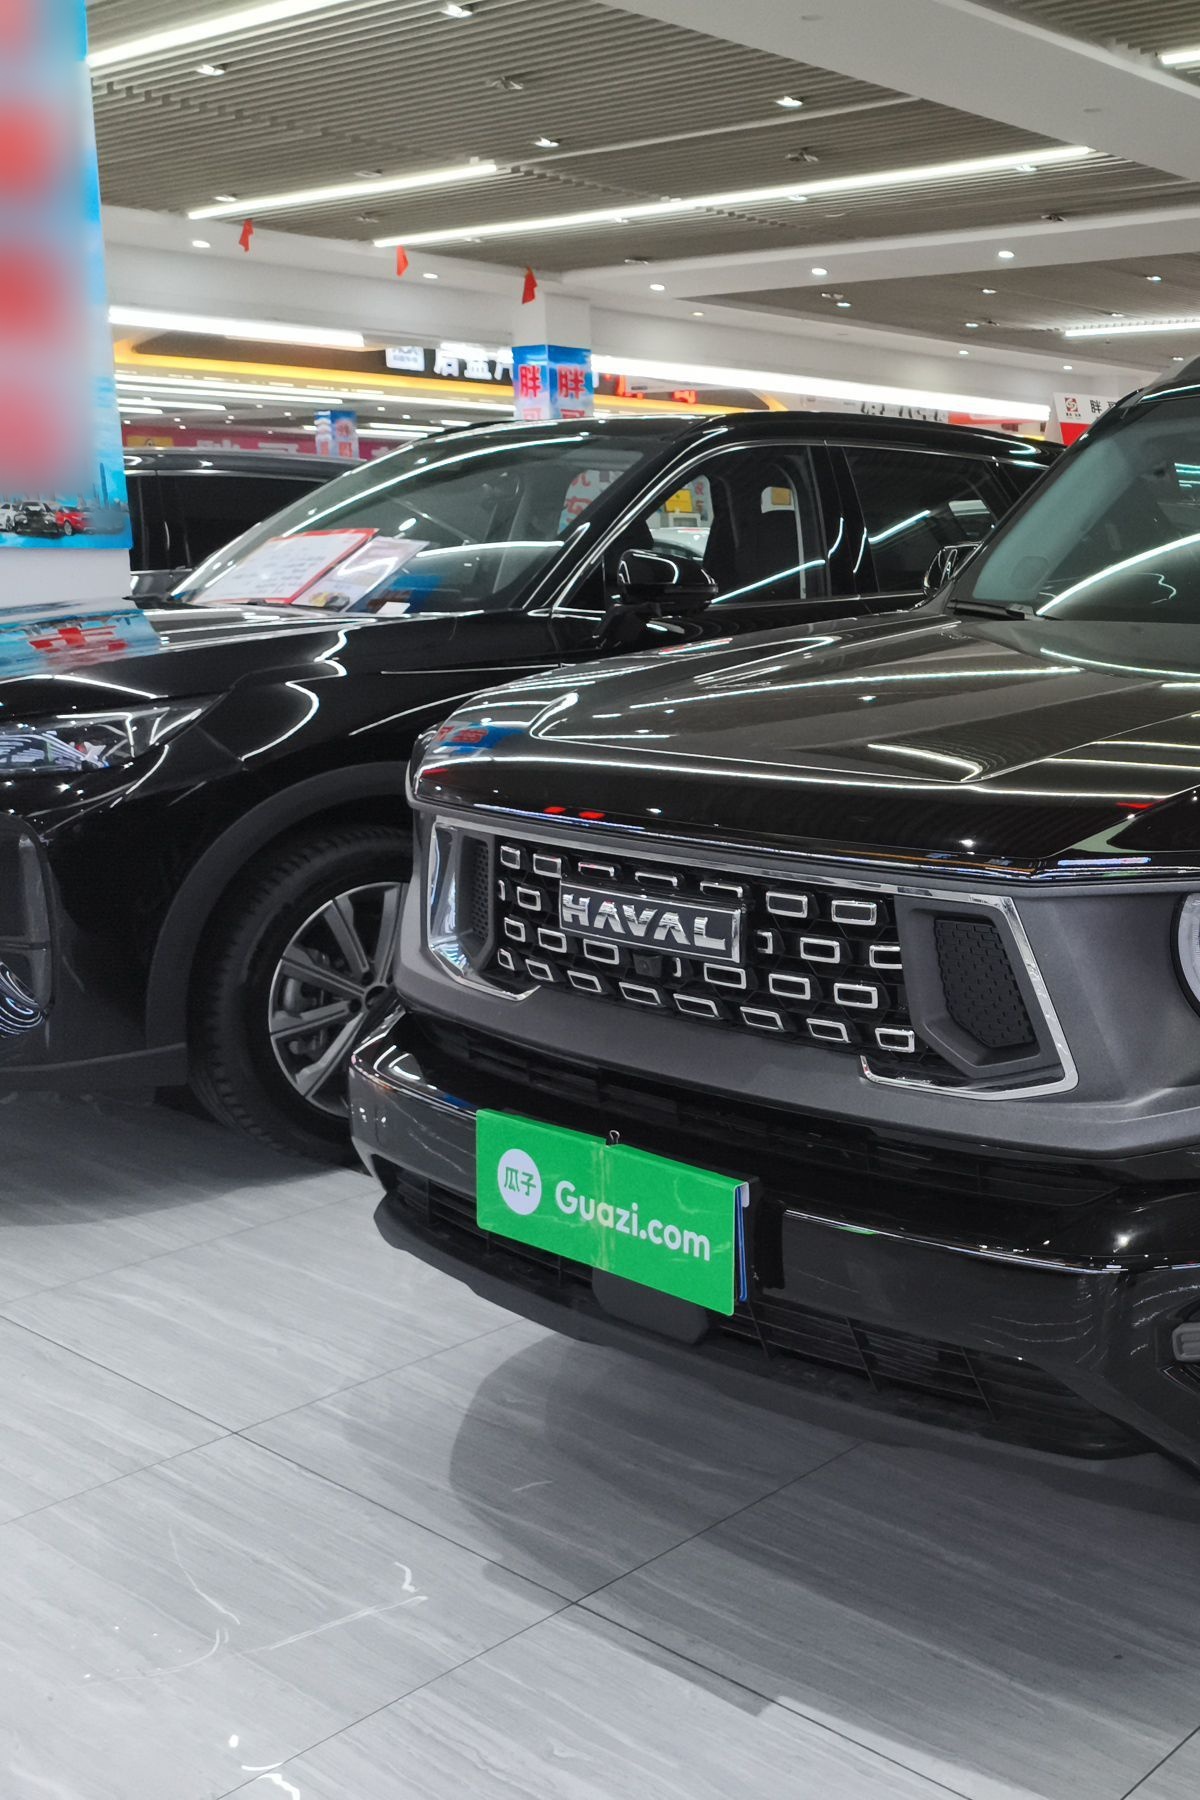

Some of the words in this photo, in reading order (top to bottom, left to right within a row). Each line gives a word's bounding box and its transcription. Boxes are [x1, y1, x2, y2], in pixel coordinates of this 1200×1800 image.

[562, 893, 727, 951] HAVAL
[503, 1165, 537, 1197] 瓜子
[554, 1180, 711, 1262] Guazi.com
